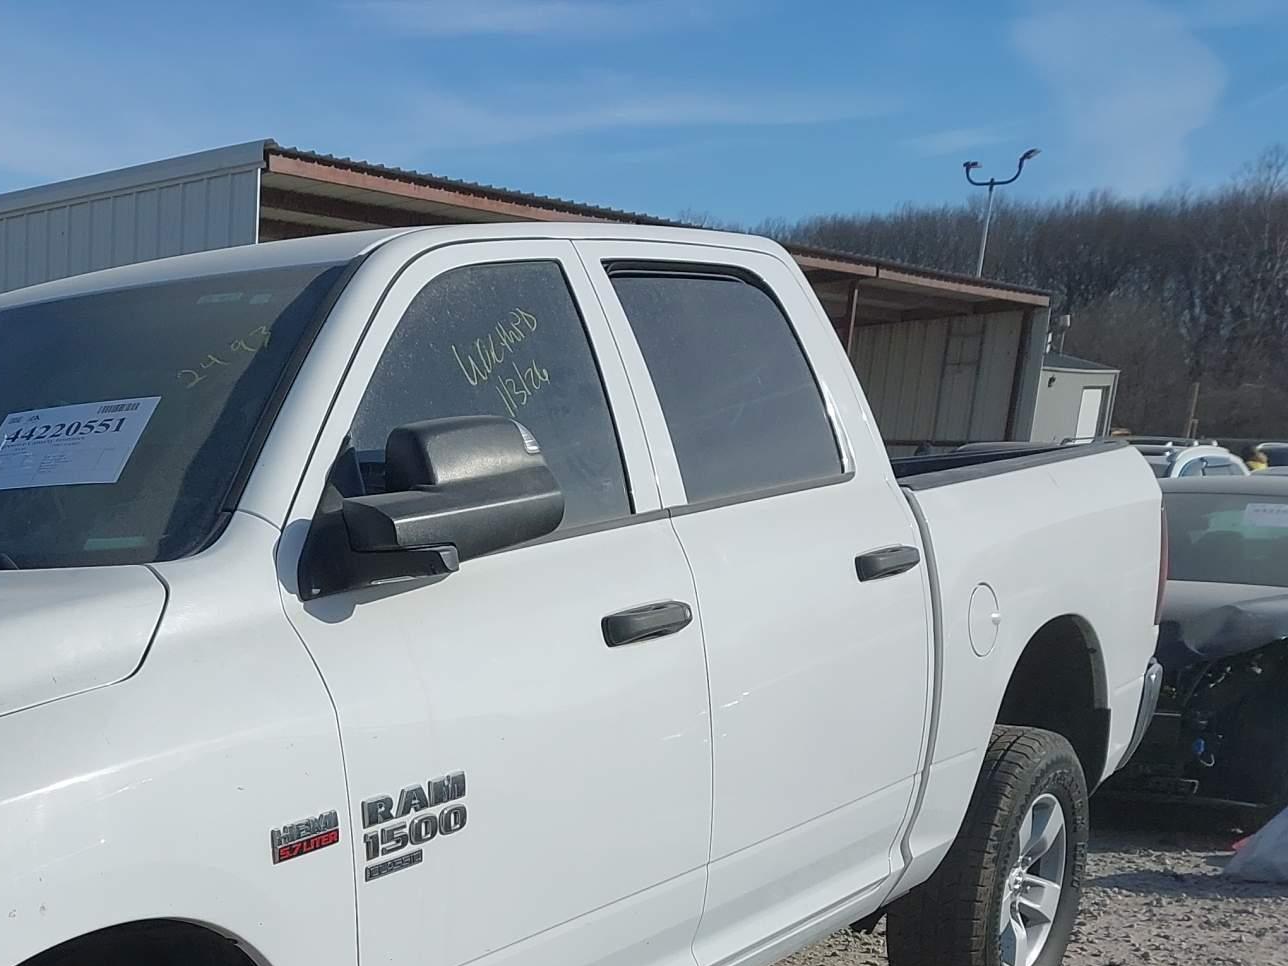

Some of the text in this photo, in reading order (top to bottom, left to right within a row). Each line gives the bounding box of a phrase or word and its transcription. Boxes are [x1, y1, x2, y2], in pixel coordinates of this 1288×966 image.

[6, 417, 126, 443] 44220551
[362, 770, 466, 829] RAM
[271, 809, 339, 847] HEMI
[279, 831, 339, 861] 5.7 LITER
[363, 803, 467, 861] 1500
